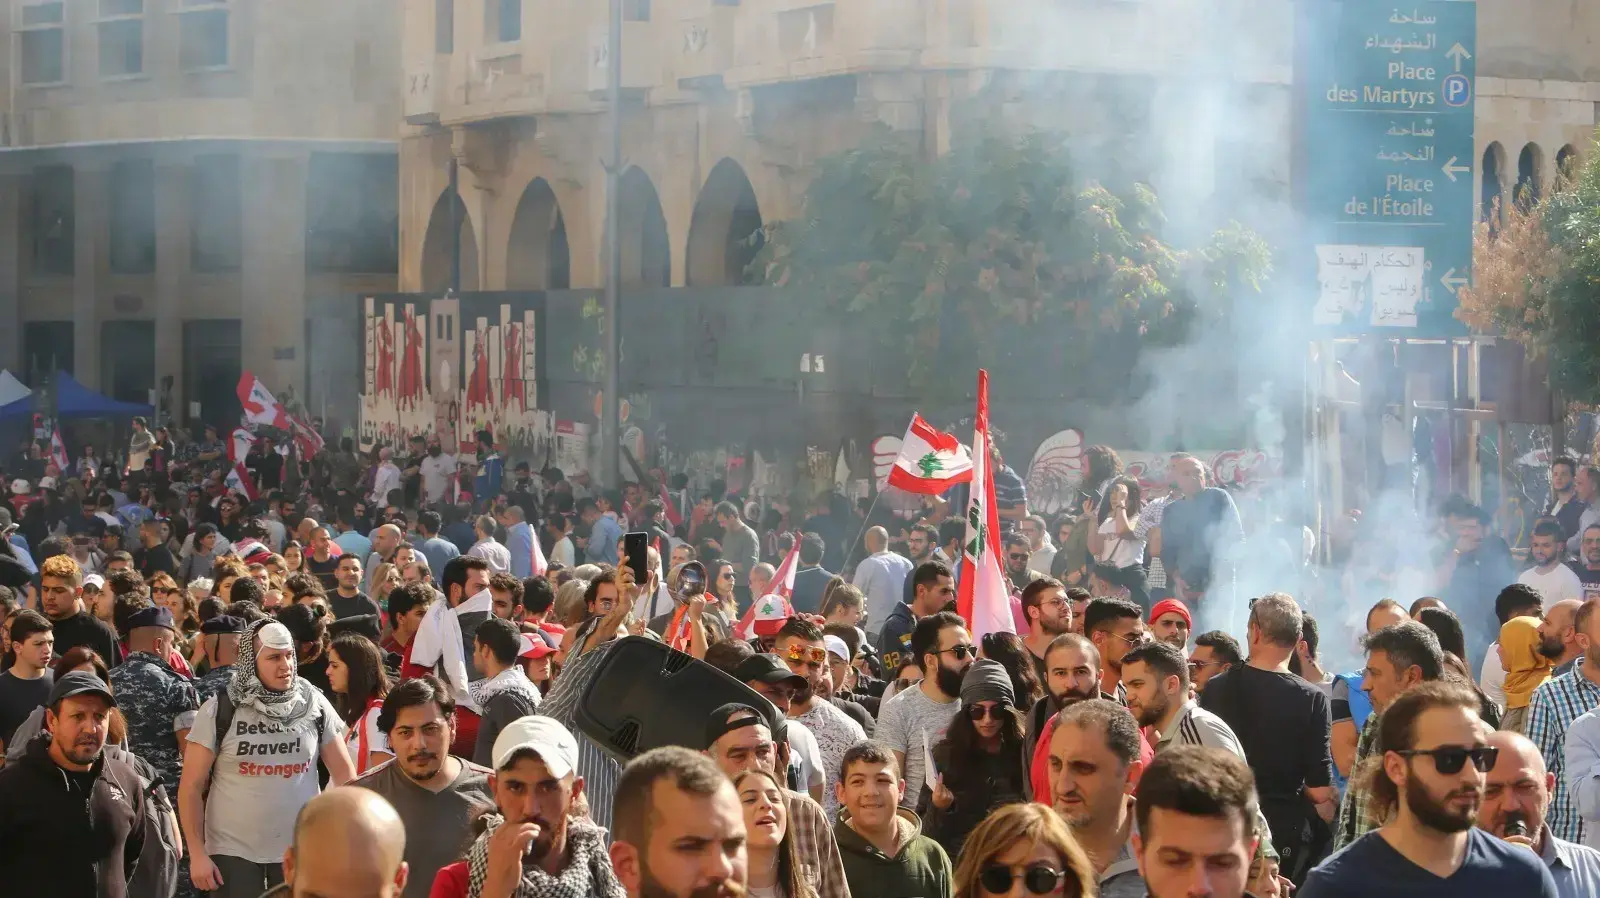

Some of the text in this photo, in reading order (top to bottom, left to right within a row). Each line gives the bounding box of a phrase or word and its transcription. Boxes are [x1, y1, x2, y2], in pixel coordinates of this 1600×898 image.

[1388, 8, 1437, 24] ساحة
[1364, 32, 1437, 53] الشهداء
[1388, 61, 1436, 80] Place
[1326, 83, 1436, 108] des Martyrs
[1449, 80, 1464, 101] P
[1375, 146, 1435, 165] النجمة
[1386, 174, 1434, 192] Place
[1344, 194, 1434, 216] de l'Étoile
[236, 738, 301, 756] Braver!
[238, 758, 311, 778] Stronger!
